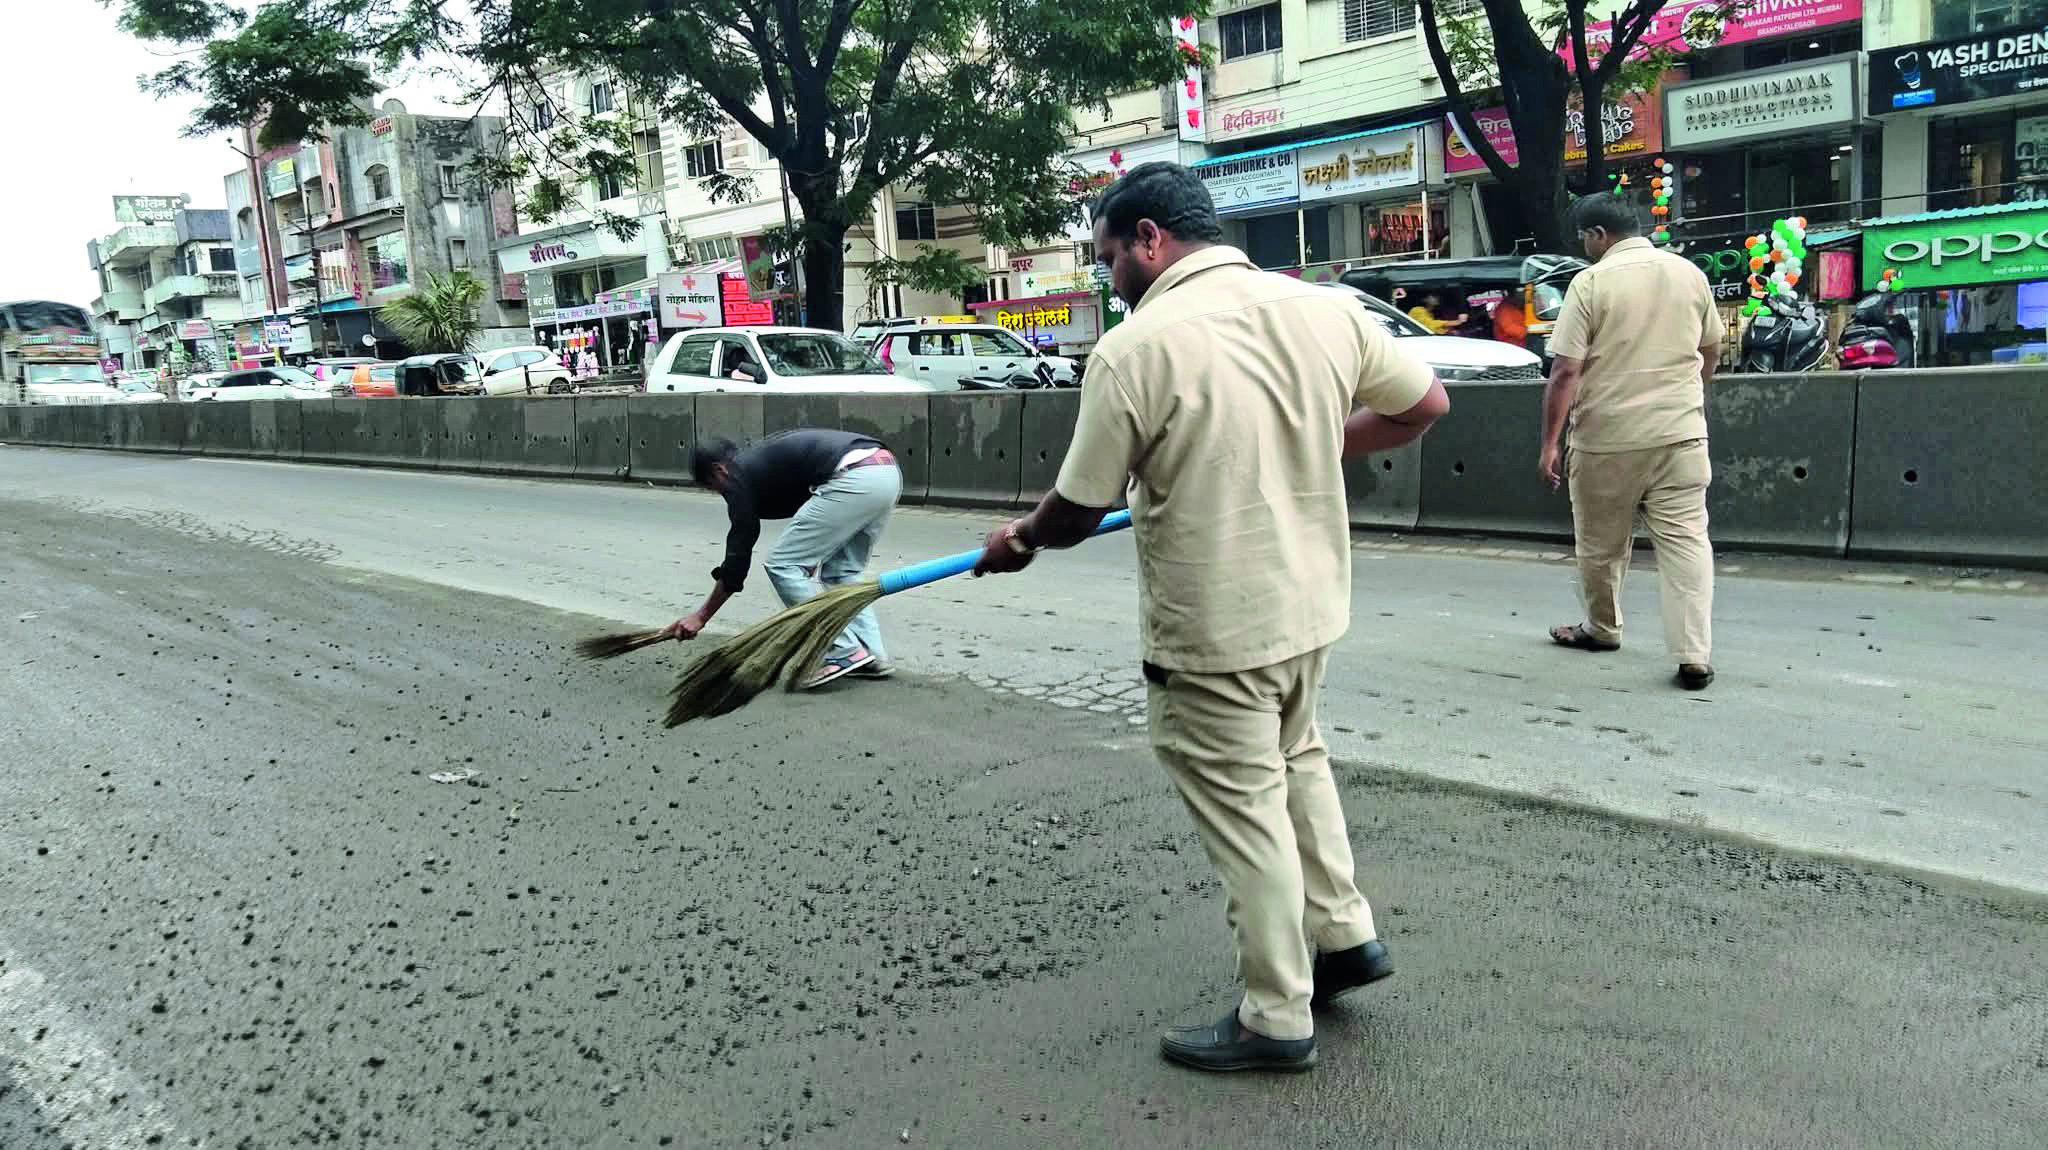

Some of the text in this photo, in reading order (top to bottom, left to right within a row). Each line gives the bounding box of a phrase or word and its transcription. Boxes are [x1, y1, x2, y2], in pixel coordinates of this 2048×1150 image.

[1927, 41, 1989, 69] YASH
[1685, 72, 1833, 107] SIDDHIVINAYAK
[1222, 158, 1266, 176] ZUNJURKE
[1268, 157, 1276, 169] &
[1277, 153, 1294, 167] CO.
[1883, 231, 2048, 266] opp
